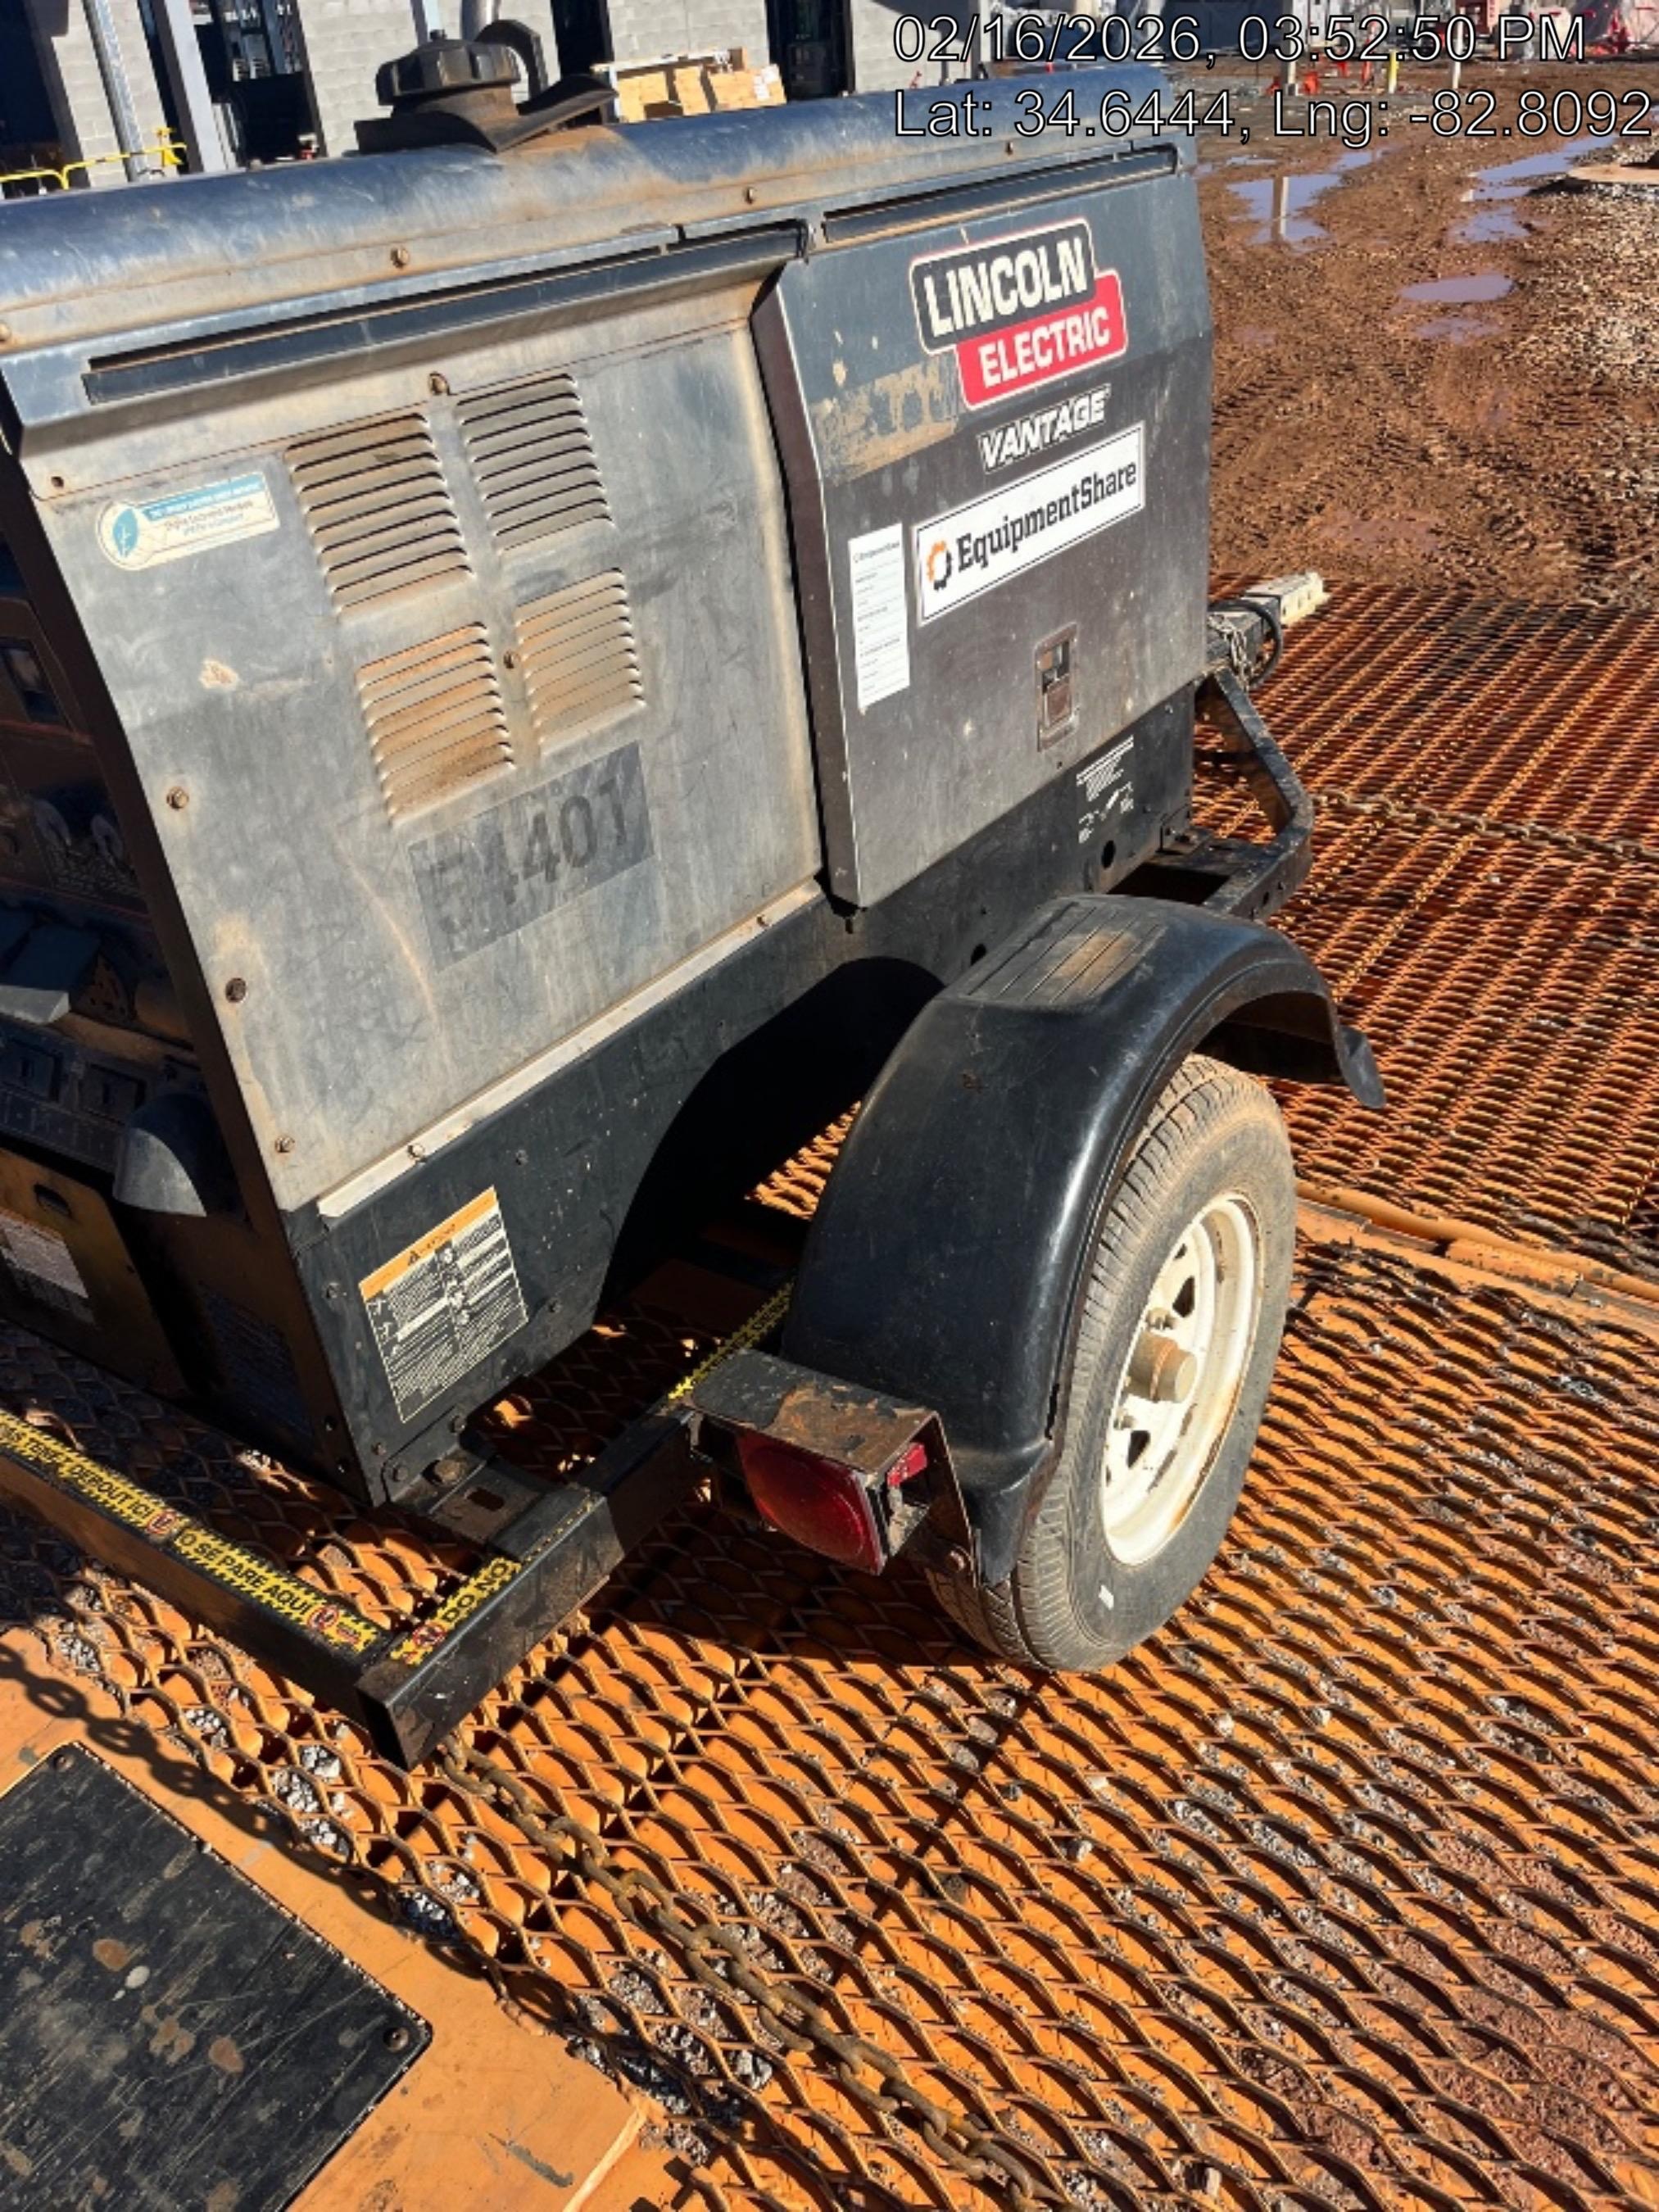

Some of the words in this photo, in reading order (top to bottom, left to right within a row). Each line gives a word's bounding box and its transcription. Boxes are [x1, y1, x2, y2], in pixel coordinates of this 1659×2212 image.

[923, 236, 1088, 338] LINCOLN
[977, 306, 1110, 388] ELECTRIC
[979, 388, 1109, 473] VANTAGE
[956, 461, 1137, 572] EquipmentShare
[215, 1555, 269, 1588] PARE
[262, 1584, 313, 1616] AQUI
[442, 1593, 475, 1620] DO
